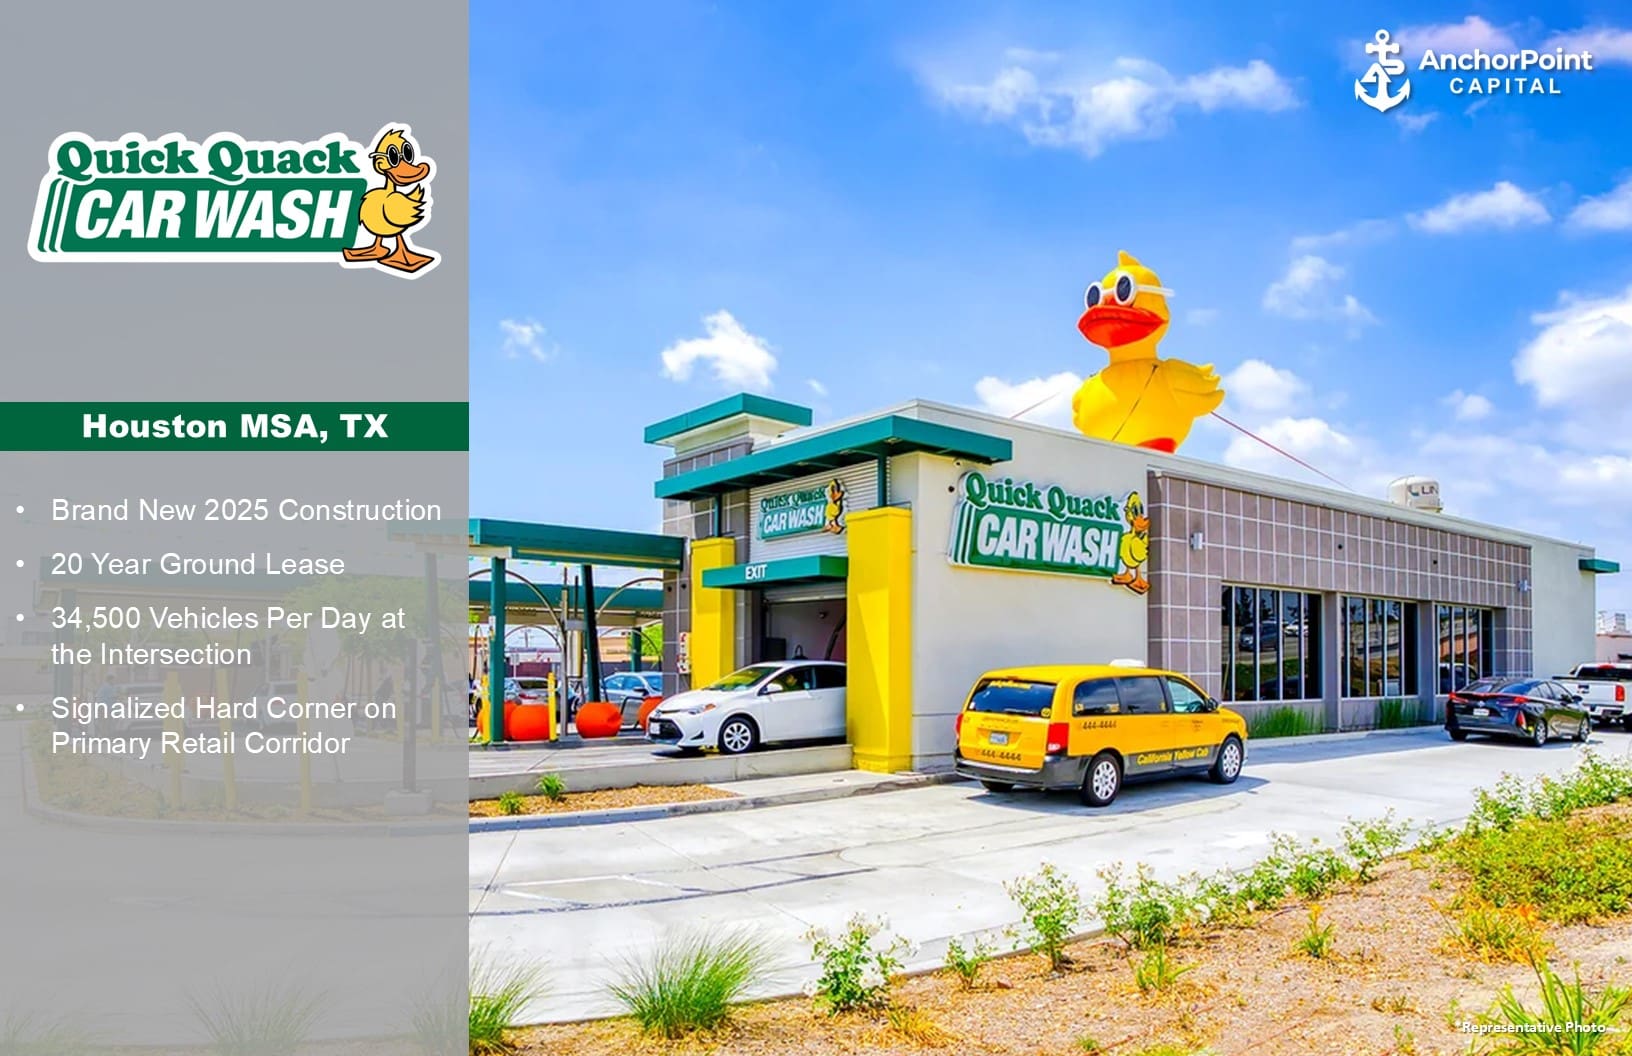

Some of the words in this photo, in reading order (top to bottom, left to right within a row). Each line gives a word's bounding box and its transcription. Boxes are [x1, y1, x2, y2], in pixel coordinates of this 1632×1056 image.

[965, 471, 1043, 508] Quick
[1047, 486, 1121, 521] Quack
[763, 512, 788, 534] CAR
[788, 504, 825, 529] WASH
[976, 512, 1040, 560] CAR
[1041, 520, 1119, 568] WASH
[745, 563, 768, 580] EXIT
